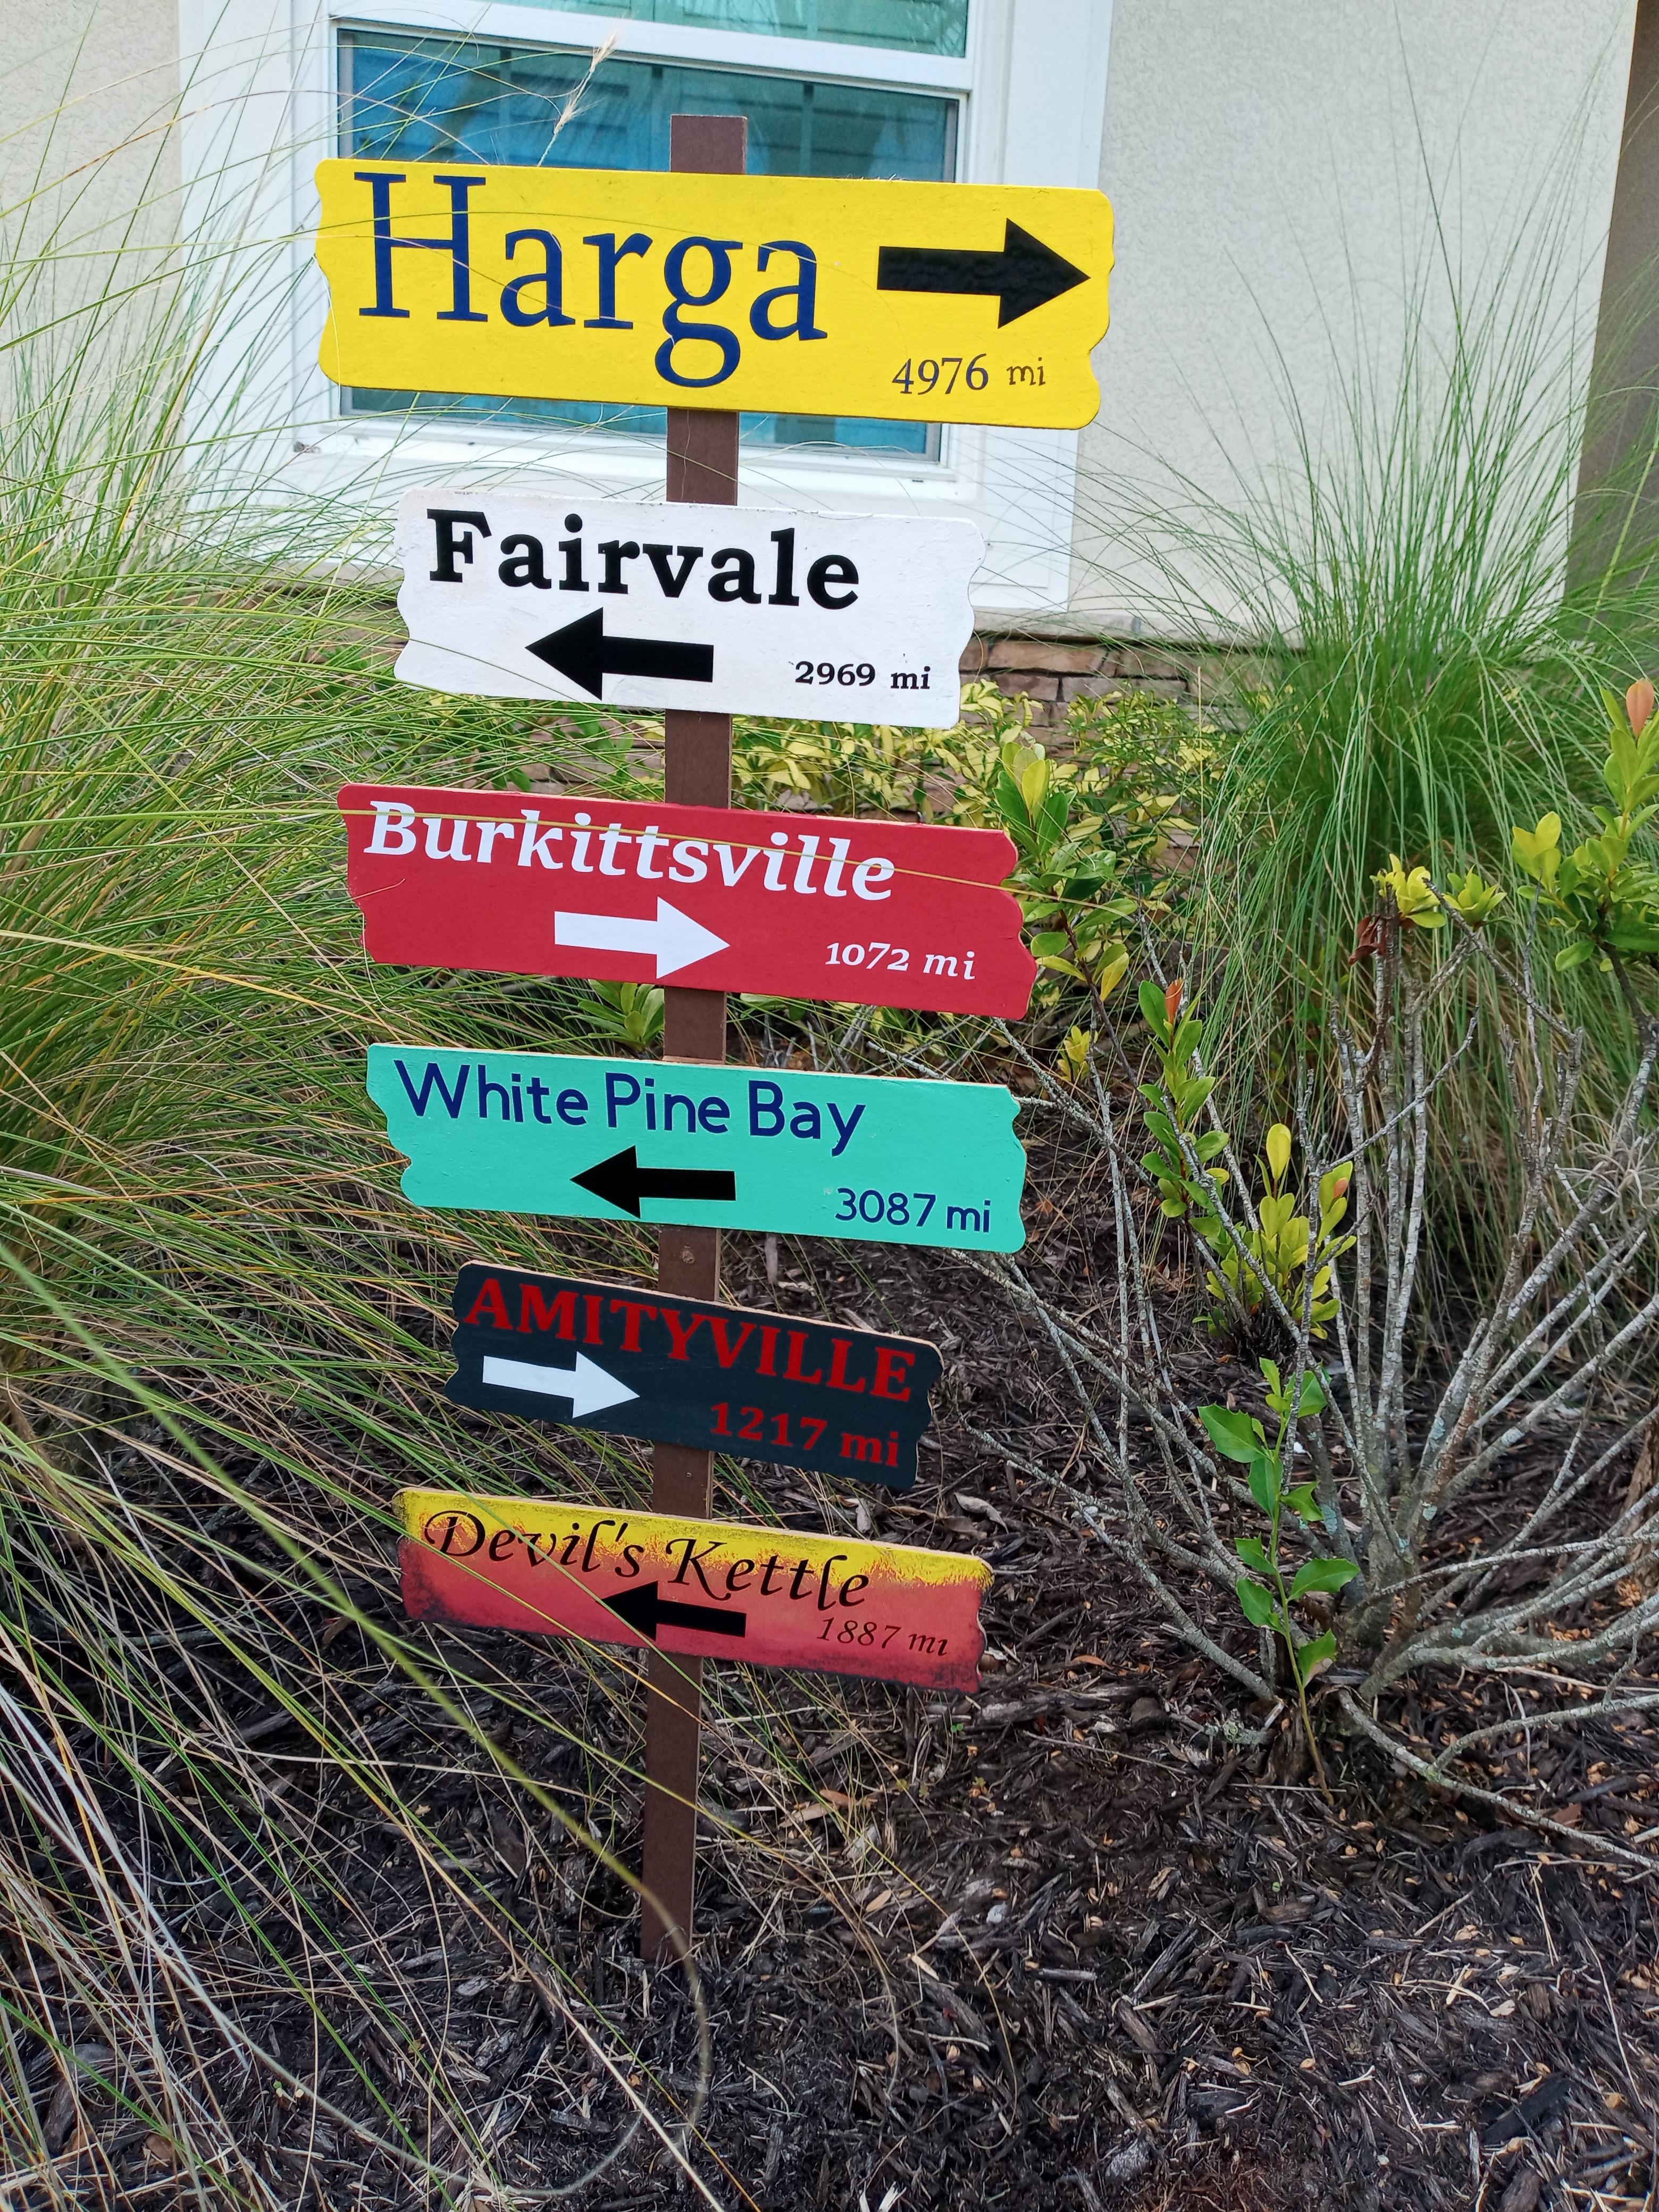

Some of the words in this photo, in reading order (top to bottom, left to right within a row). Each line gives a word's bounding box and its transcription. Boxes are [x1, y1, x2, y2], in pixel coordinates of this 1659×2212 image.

[354, 172, 827, 388] Harga
[892, 353, 989, 395] 4976
[1006, 357, 1046, 387] mi
[426, 508, 860, 610] Fairvale
[794, 661, 876, 687] 2969
[891, 666, 931, 690] mi
[364, 800, 895, 901] Burkittsville
[825, 942, 909, 971] 1072
[923, 950, 975, 981] mi
[393, 1060, 588, 1126] White
[606, 1073, 730, 1134] Pine
[748, 1079, 866, 1157] Bay
[835, 1187, 937, 1227] 3087
[946, 1200, 991, 1233] mi
[463, 1278, 915, 1402] AMITYVILLE
[710, 1402, 827, 1451] 1217
[839, 1431, 900, 1468] mi
[424, 1510, 645, 1578] Devil's
[666, 1538, 869, 1611] Kettle
[817, 1616, 902, 1650] 1887
[909, 1631, 950, 1656] mi
